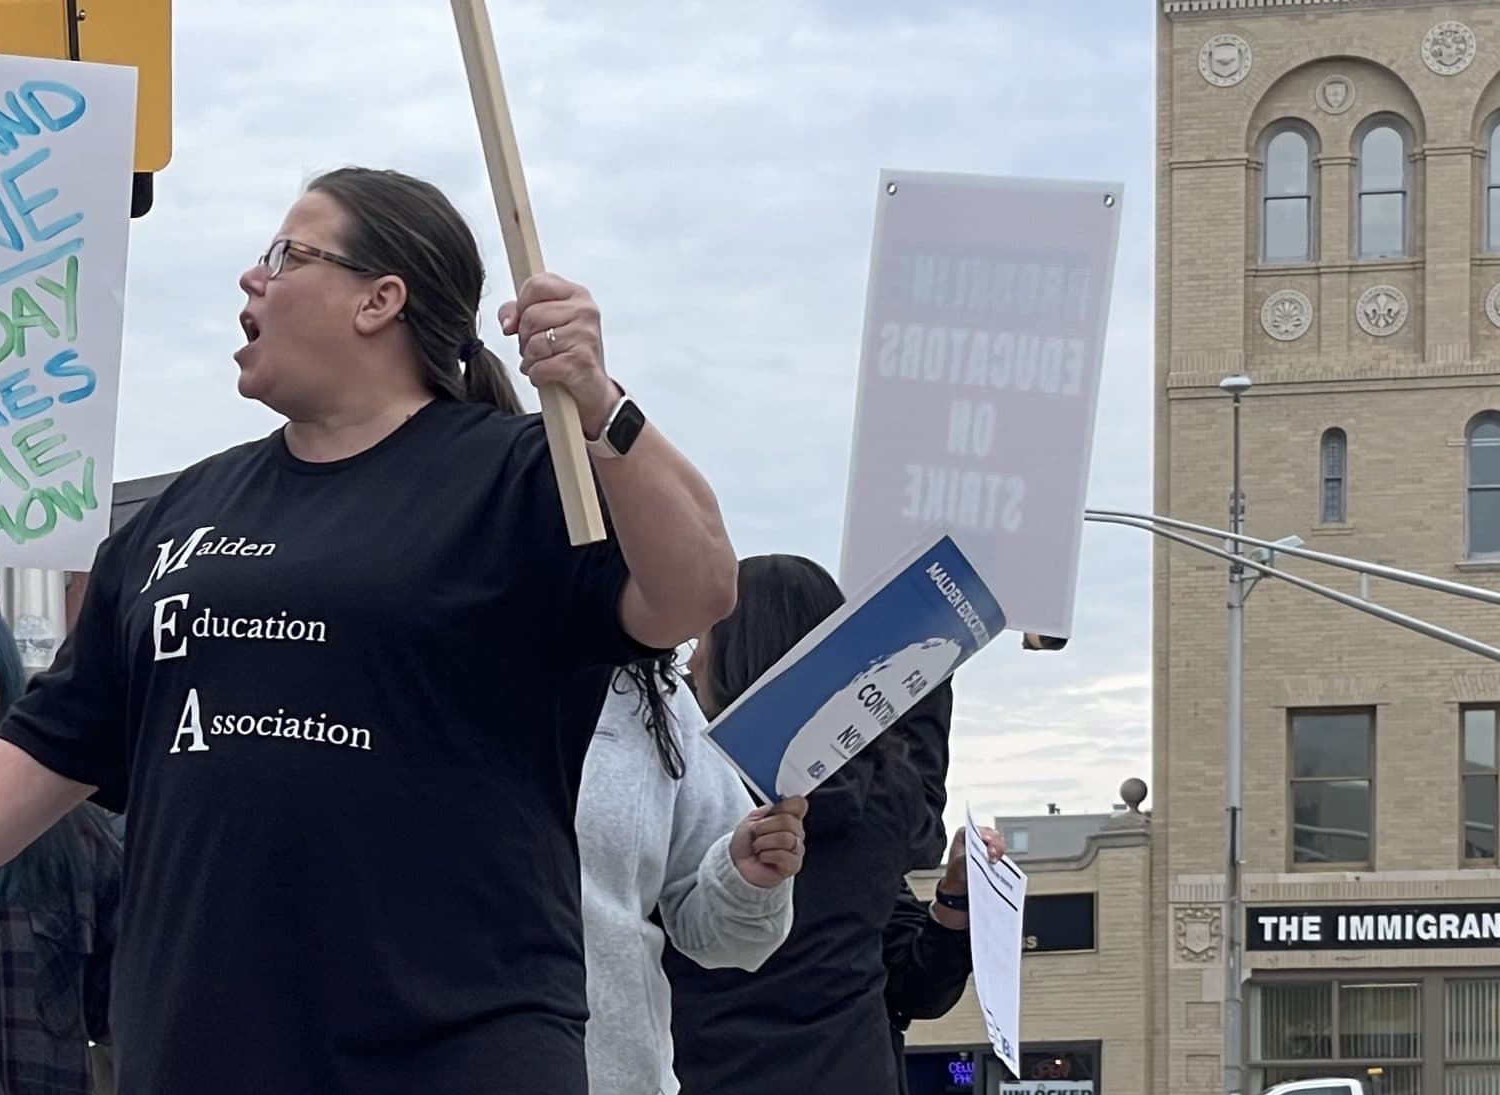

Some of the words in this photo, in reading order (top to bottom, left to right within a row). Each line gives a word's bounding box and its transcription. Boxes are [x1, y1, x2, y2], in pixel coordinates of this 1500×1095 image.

[140, 526, 276, 593] Malden
[925, 561, 966, 609] MALDEN
[153, 593, 327, 662] Education
[169, 688, 372, 754] Association
[1258, 915, 1322, 942] THE
[1337, 912, 1500, 942] IMMIGRAN
